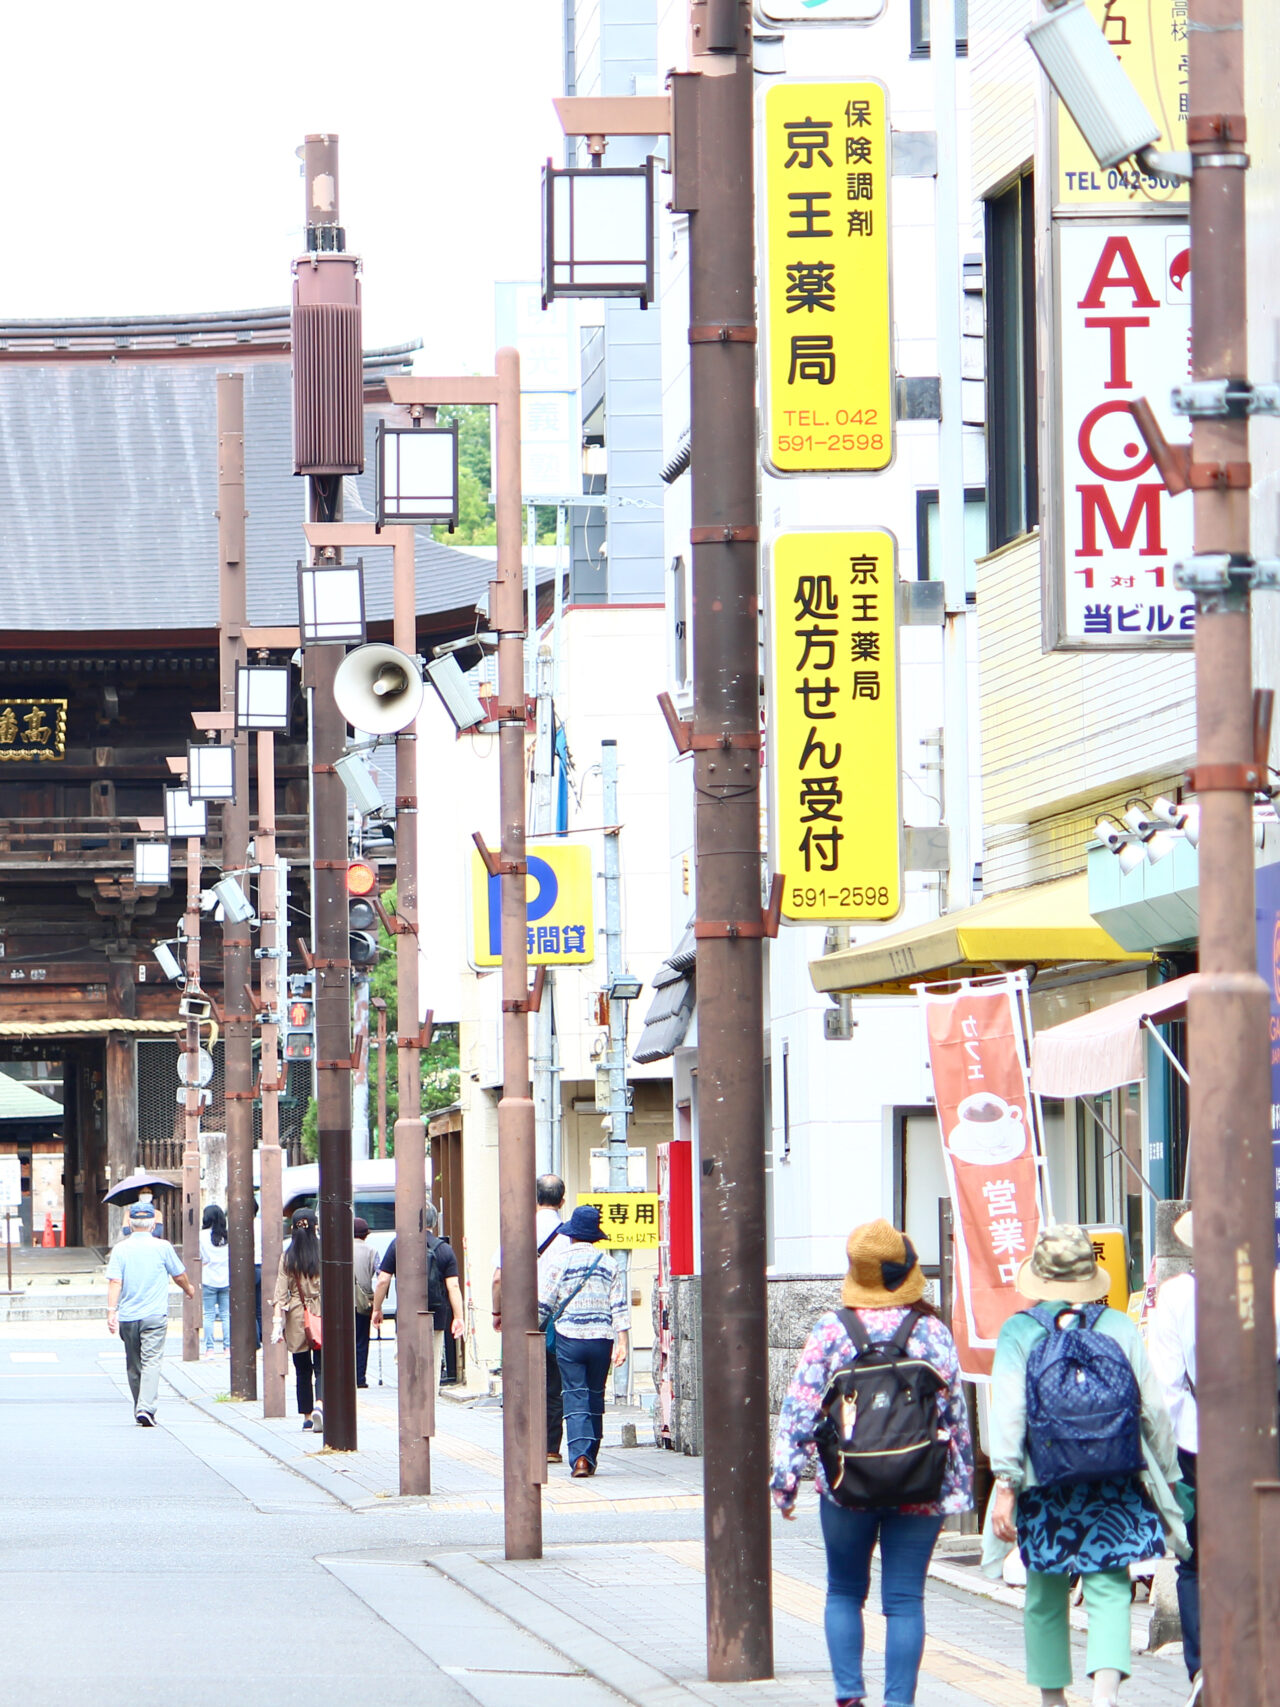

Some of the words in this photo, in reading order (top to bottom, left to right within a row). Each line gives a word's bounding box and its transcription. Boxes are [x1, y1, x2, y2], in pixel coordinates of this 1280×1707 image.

[844, 100, 873, 237] 保険調剤
[1065, 171, 1101, 191] TEL
[784, 116, 837, 386] 京王薬局
[778, 434, 884, 452] 591-2598
[835, 409, 878, 426] 042
[849, 554, 880, 701] 京王薬局
[793, 575, 843, 872] 処方せん受付
[792, 887, 889, 908] 591-2598
